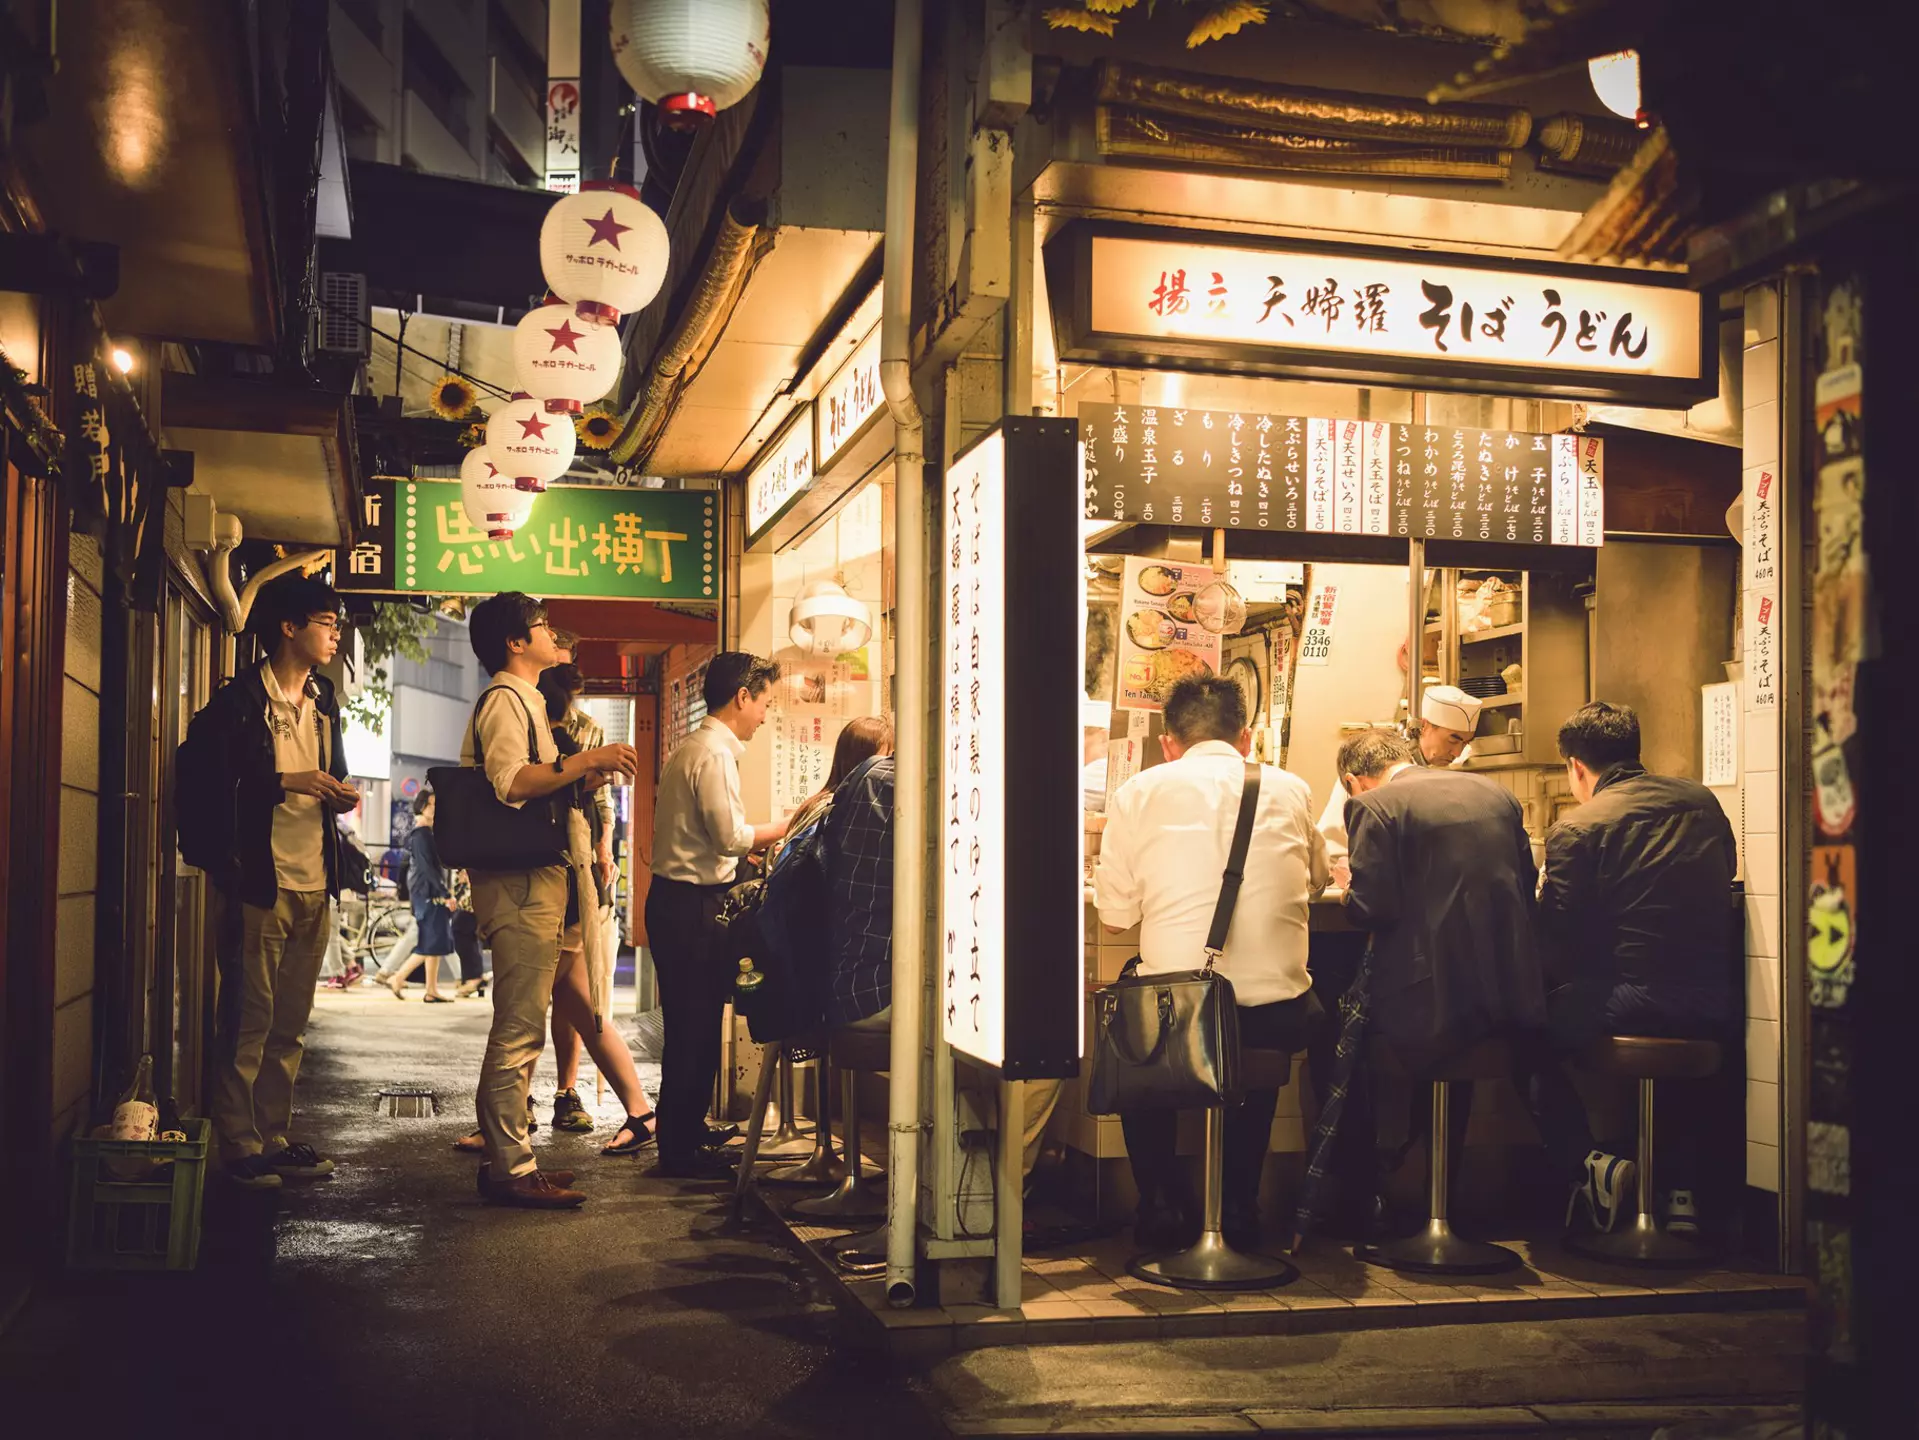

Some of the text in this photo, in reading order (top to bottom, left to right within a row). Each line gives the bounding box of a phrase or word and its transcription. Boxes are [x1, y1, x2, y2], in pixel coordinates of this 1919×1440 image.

[566, 254, 639, 276] サッポロ ラガービール
[1257, 276, 1389, 334] 天婦羅
[1419, 279, 1515, 352] そば
[1541, 289, 1648, 359] うどん
[531, 360, 596, 372] サッポロ ラガービール
[506, 446, 528, 454] サッポロ
[1112, 406, 1129, 463] 大盛り
[1140, 409, 1158, 485] 温泉玉子
[1172, 410, 1188, 466] ざる
[1202, 412, 1213, 468] もり
[1227, 413, 1245, 496] 冷しきつね
[1256, 415, 1273, 498] 冷したぬき
[1285, 418, 1301, 501] 天ぷらせいろ
[1396, 425, 1411, 475] きつね
[1424, 428, 1439, 477] わかめ
[1450, 430, 1466, 483] とろろ昆布
[1478, 431, 1493, 481] たぬき
[1504, 434, 1519, 482] かけ
[1341, 442, 1356, 503] 天玉せいろ
[1531, 436, 1546, 484] 玉子
[1558, 438, 1572, 486] 天ぷら
[1584, 459, 1598, 490] 天玉
[435, 500, 688, 584] 思い出横丁
[1758, 500, 1772, 563] 天ぷらそば
[1303, 646, 1328, 657] 0110
[1304, 636, 1330, 647] 3346
[1309, 628, 1326, 636] 03
[1758, 626, 1772, 689] 天ぷらそば
[1124, 689, 1136, 698] Ten
